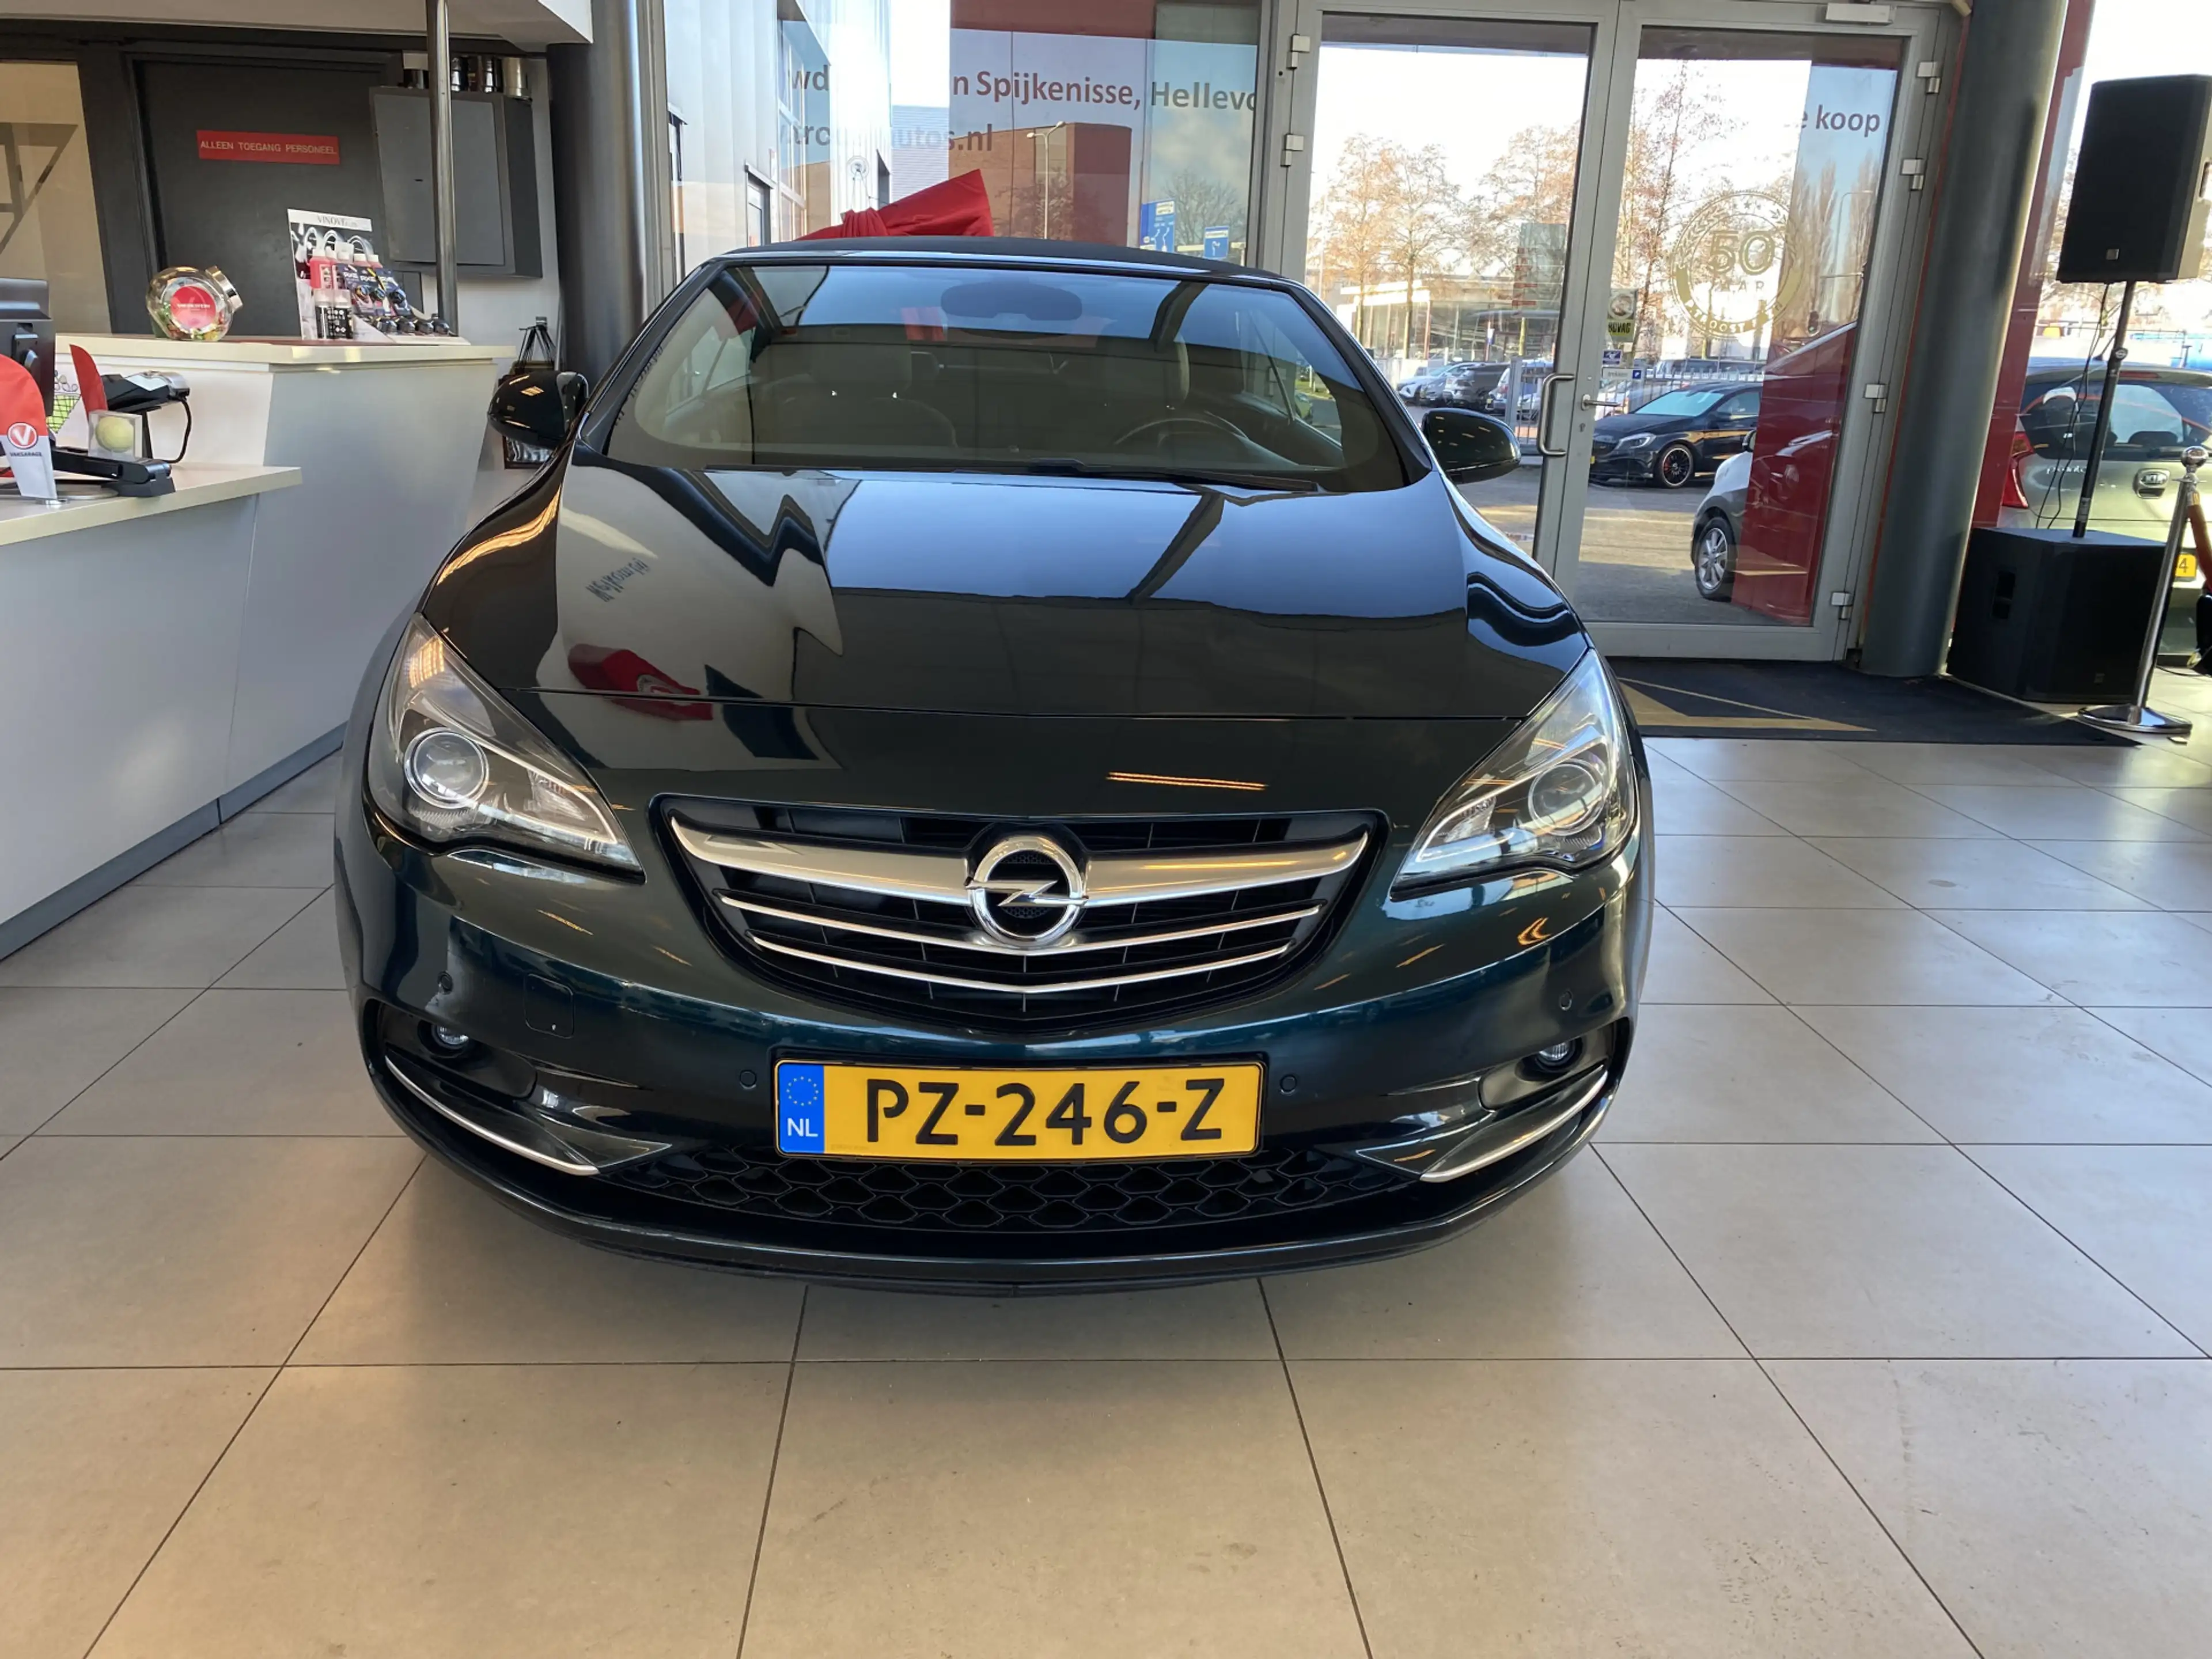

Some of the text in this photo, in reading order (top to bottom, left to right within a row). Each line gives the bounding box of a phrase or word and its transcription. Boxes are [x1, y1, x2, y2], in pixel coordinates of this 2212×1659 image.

[976, 70, 1141, 110] Spijkenisse,
[1816, 104, 1880, 138] koop
[200, 141, 337, 154] ALLEEN TOEGANG PERSONEEL
[1708, 230, 1775, 275] 50
[787, 1118, 819, 1138] NL
[866, 1078, 1226, 1146] PZ-246-Z
